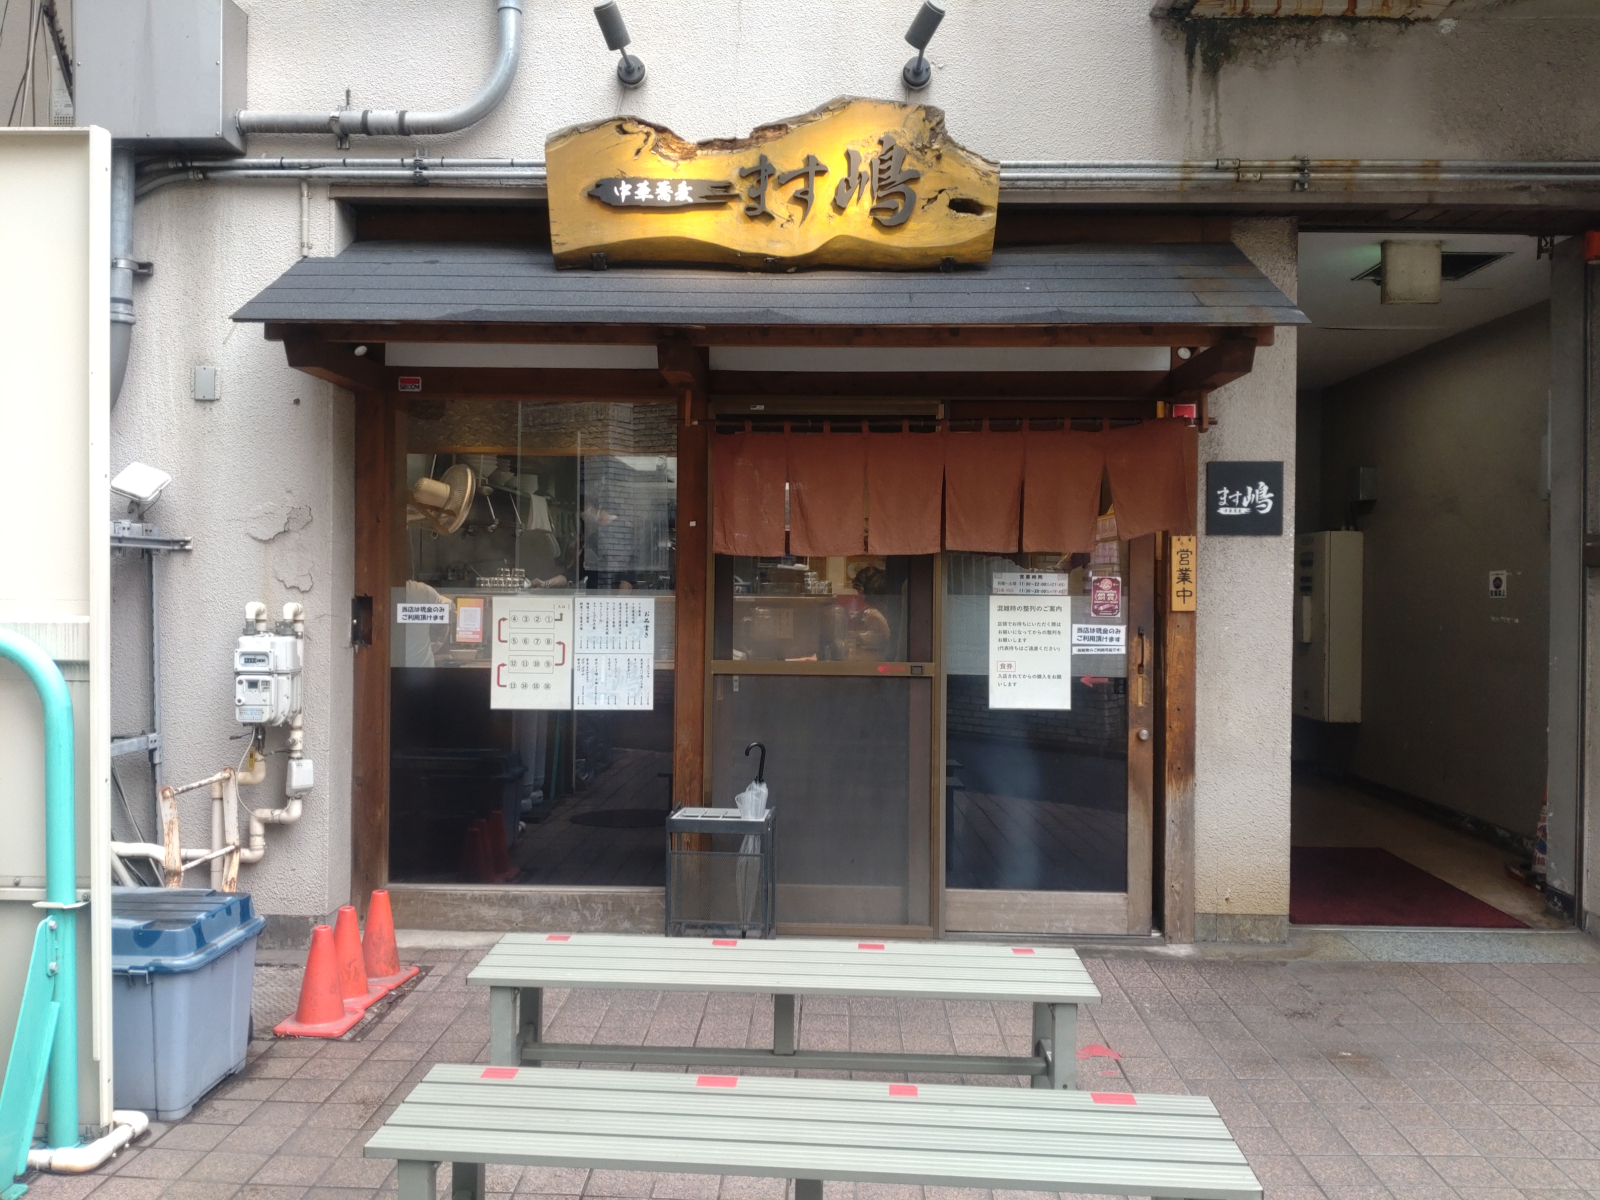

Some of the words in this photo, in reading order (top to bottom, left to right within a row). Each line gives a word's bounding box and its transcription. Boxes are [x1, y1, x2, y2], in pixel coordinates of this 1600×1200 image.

[613, 180, 694, 203] 中華蕎麦
[738, 135, 921, 228] ます嶋
[1216, 481, 1275, 515] ます嶋
[1176, 549, 1193, 604] 営業中
[643, 610, 651, 639] お品書き
[1076, 627, 1121, 635] 当店は現金のみ
[1076, 635, 1121, 643] ご利用頂けます
